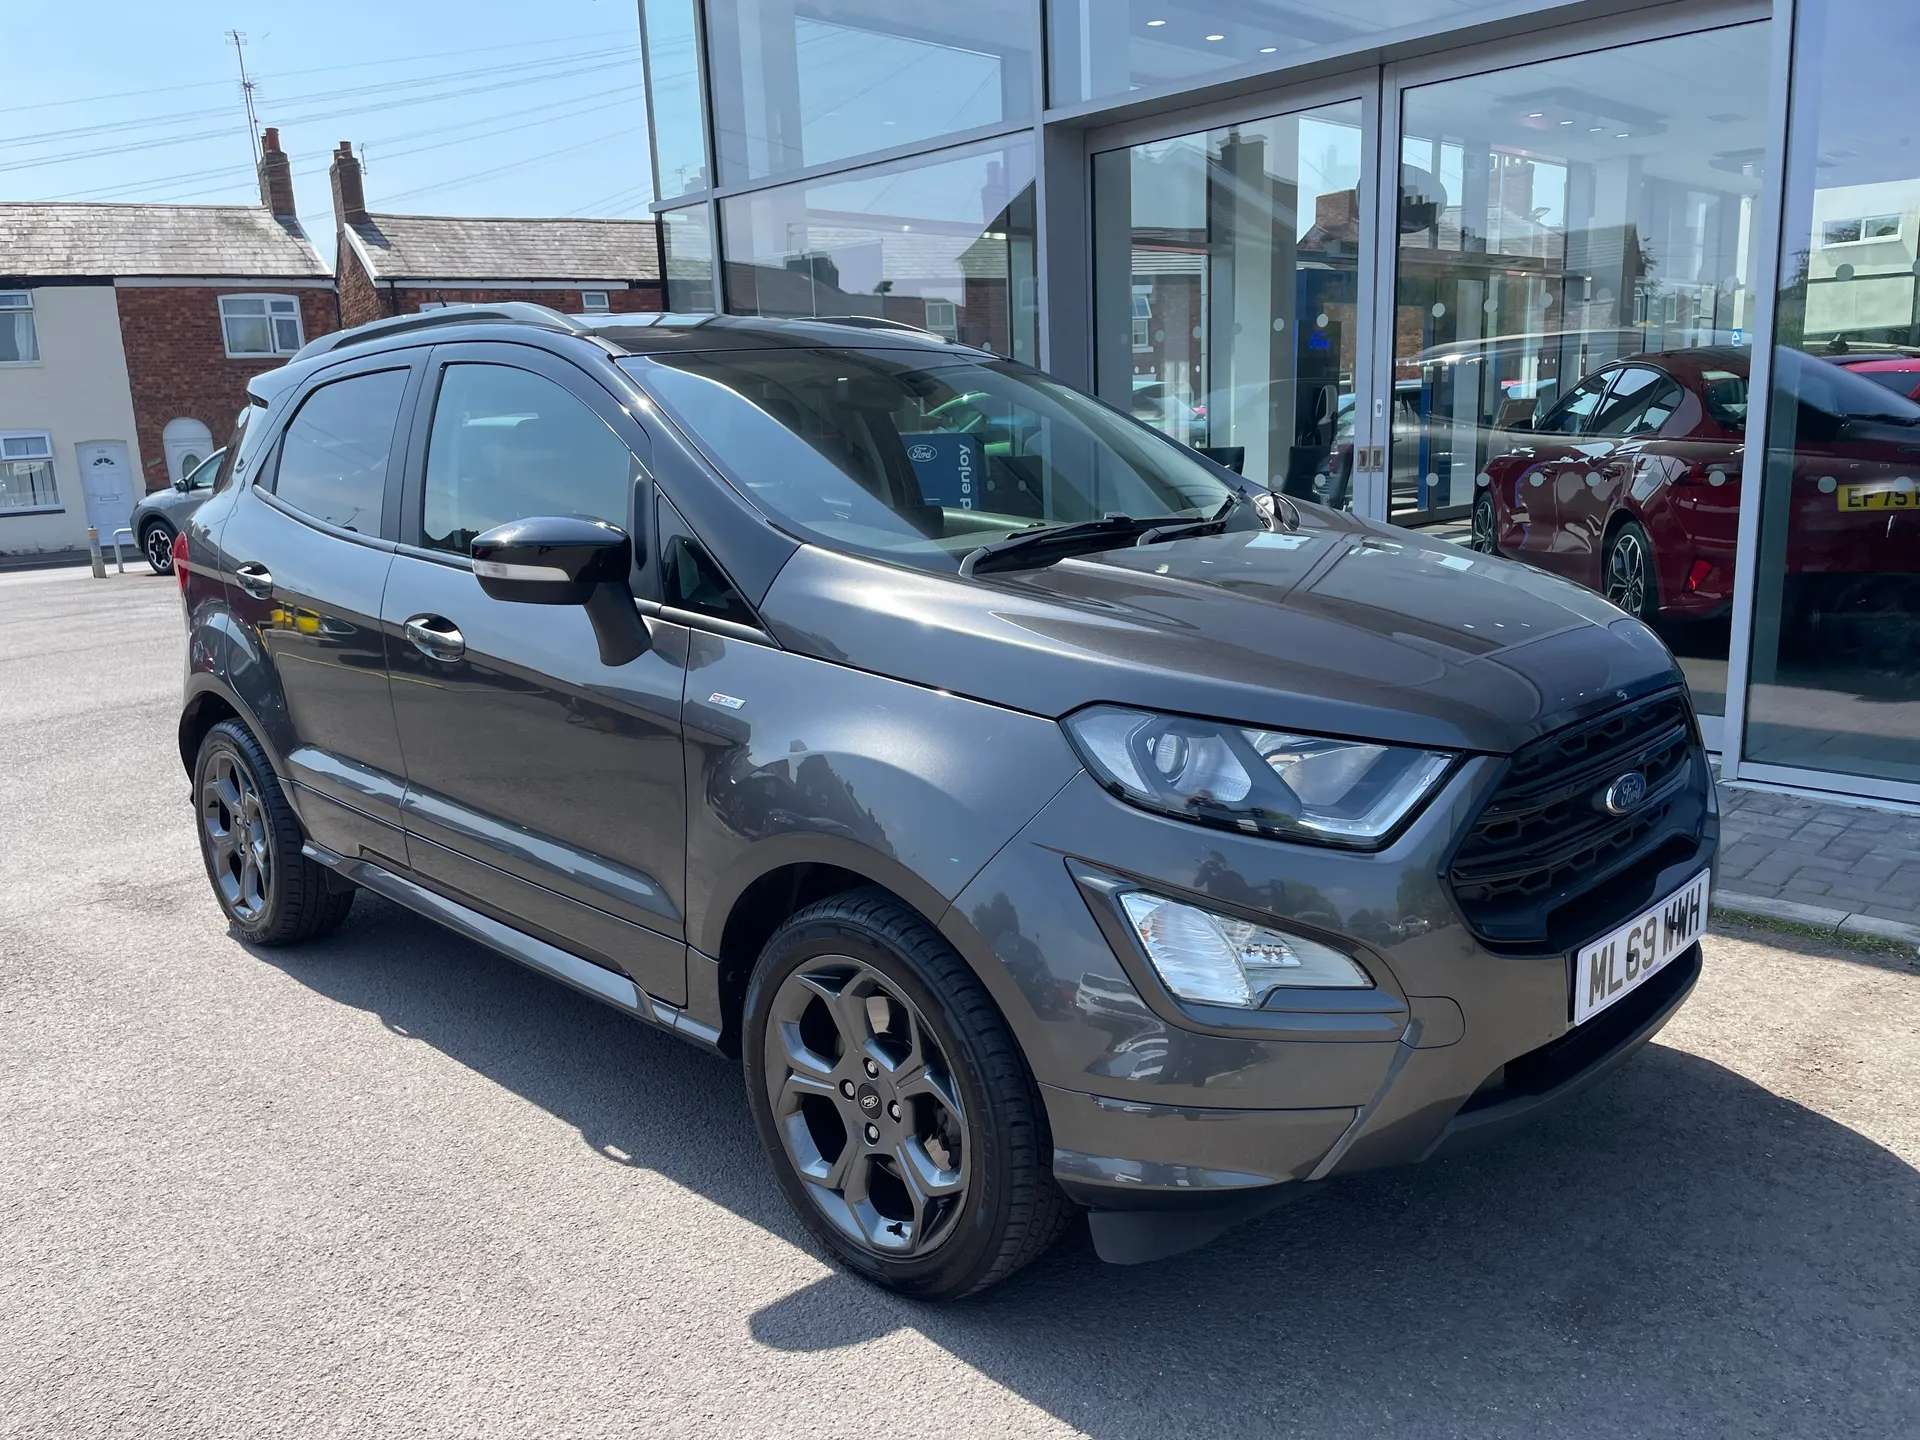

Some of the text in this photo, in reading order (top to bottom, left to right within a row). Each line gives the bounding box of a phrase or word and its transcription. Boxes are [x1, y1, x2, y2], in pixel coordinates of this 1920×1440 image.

[910, 446, 934, 460] Ford
[958, 443, 972, 494] enjoy
[1588, 882, 1702, 1008] ML69 WWH
